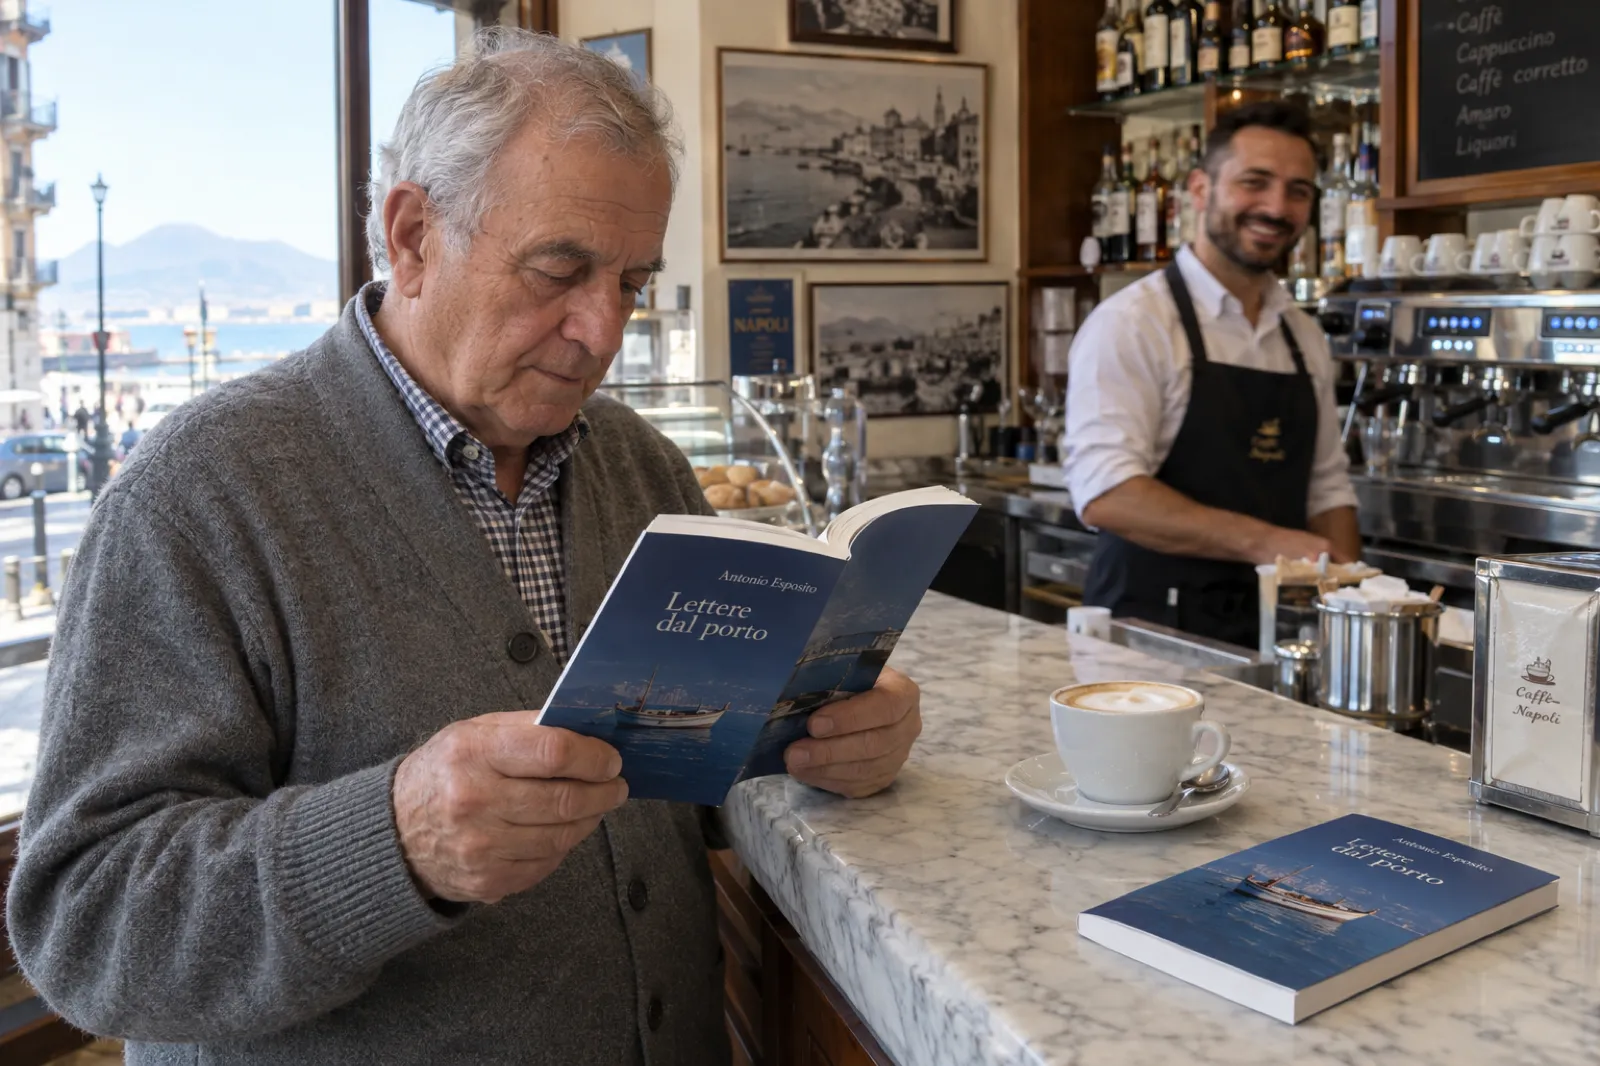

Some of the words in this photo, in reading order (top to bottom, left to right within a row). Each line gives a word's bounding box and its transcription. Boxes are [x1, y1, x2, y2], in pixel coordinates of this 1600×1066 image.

[1456, 30, 1556, 65] Cappuccino
[1513, 55, 1589, 83] corretto
[1456, 104, 1512, 126] Amaro
[1456, 129, 1518, 159] Liquori
[734, 317, 789, 333] NAPOLI
[718, 570, 769, 586] Antonio
[771, 577, 818, 594] Esposito
[665, 591, 752, 619] Lettere
[656, 612, 699, 634] dal
[698, 622, 769, 641] porto
[1512, 704, 1561, 724] Napoli
[1347, 837, 1414, 864] Lettere
[1392, 837, 1440, 855] Antonio
[1441, 852, 1493, 873] Esposito
[1331, 845, 1372, 860] dal
[1367, 859, 1444, 885] porto
